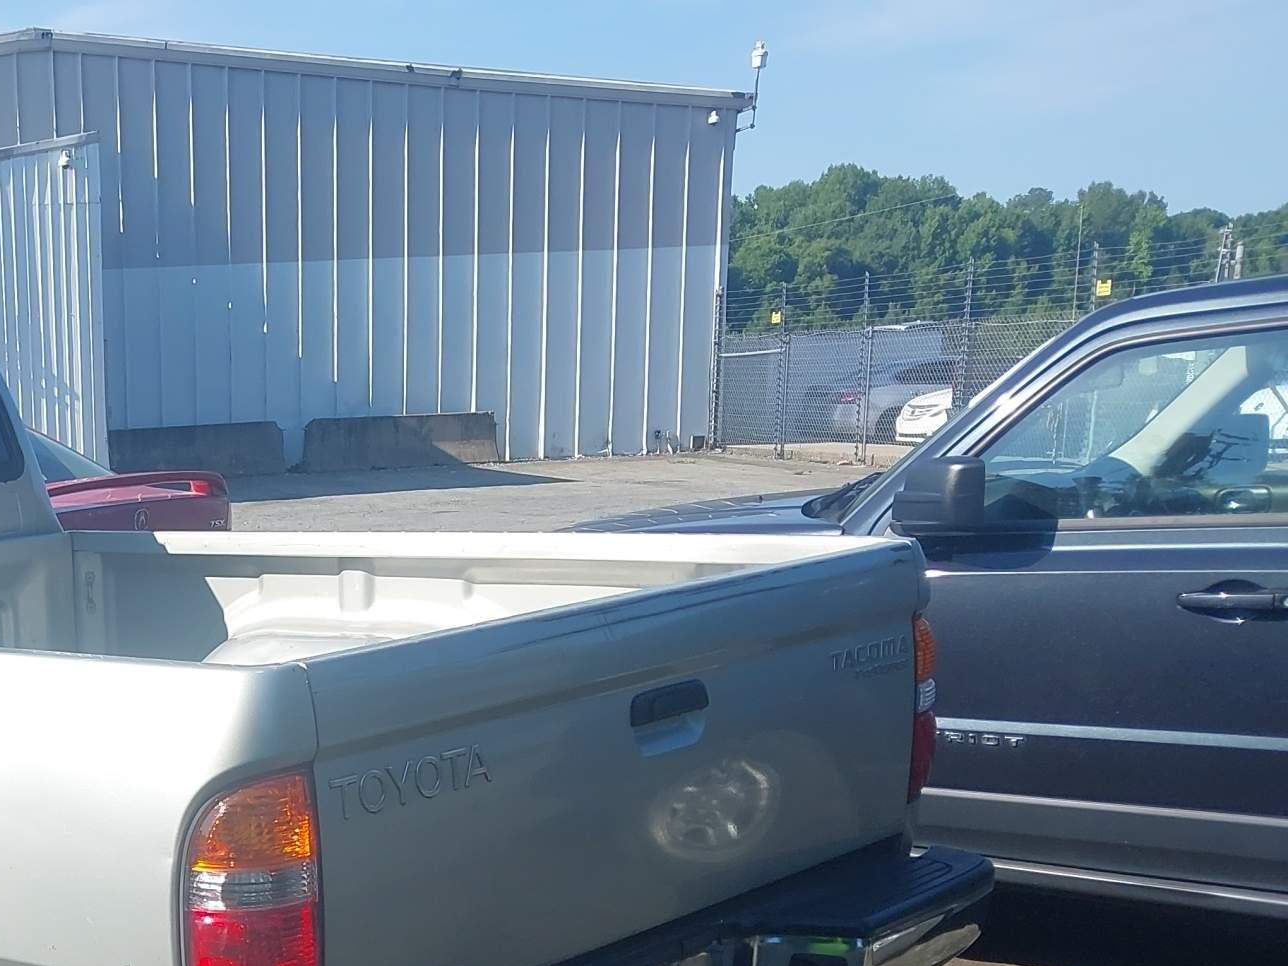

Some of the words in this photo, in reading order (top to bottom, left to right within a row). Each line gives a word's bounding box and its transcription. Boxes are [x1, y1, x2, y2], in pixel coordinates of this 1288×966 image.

[830, 634, 905, 672] TACOMA
[936, 731, 1024, 748] RIOT
[328, 744, 493, 820] TOYOTA
